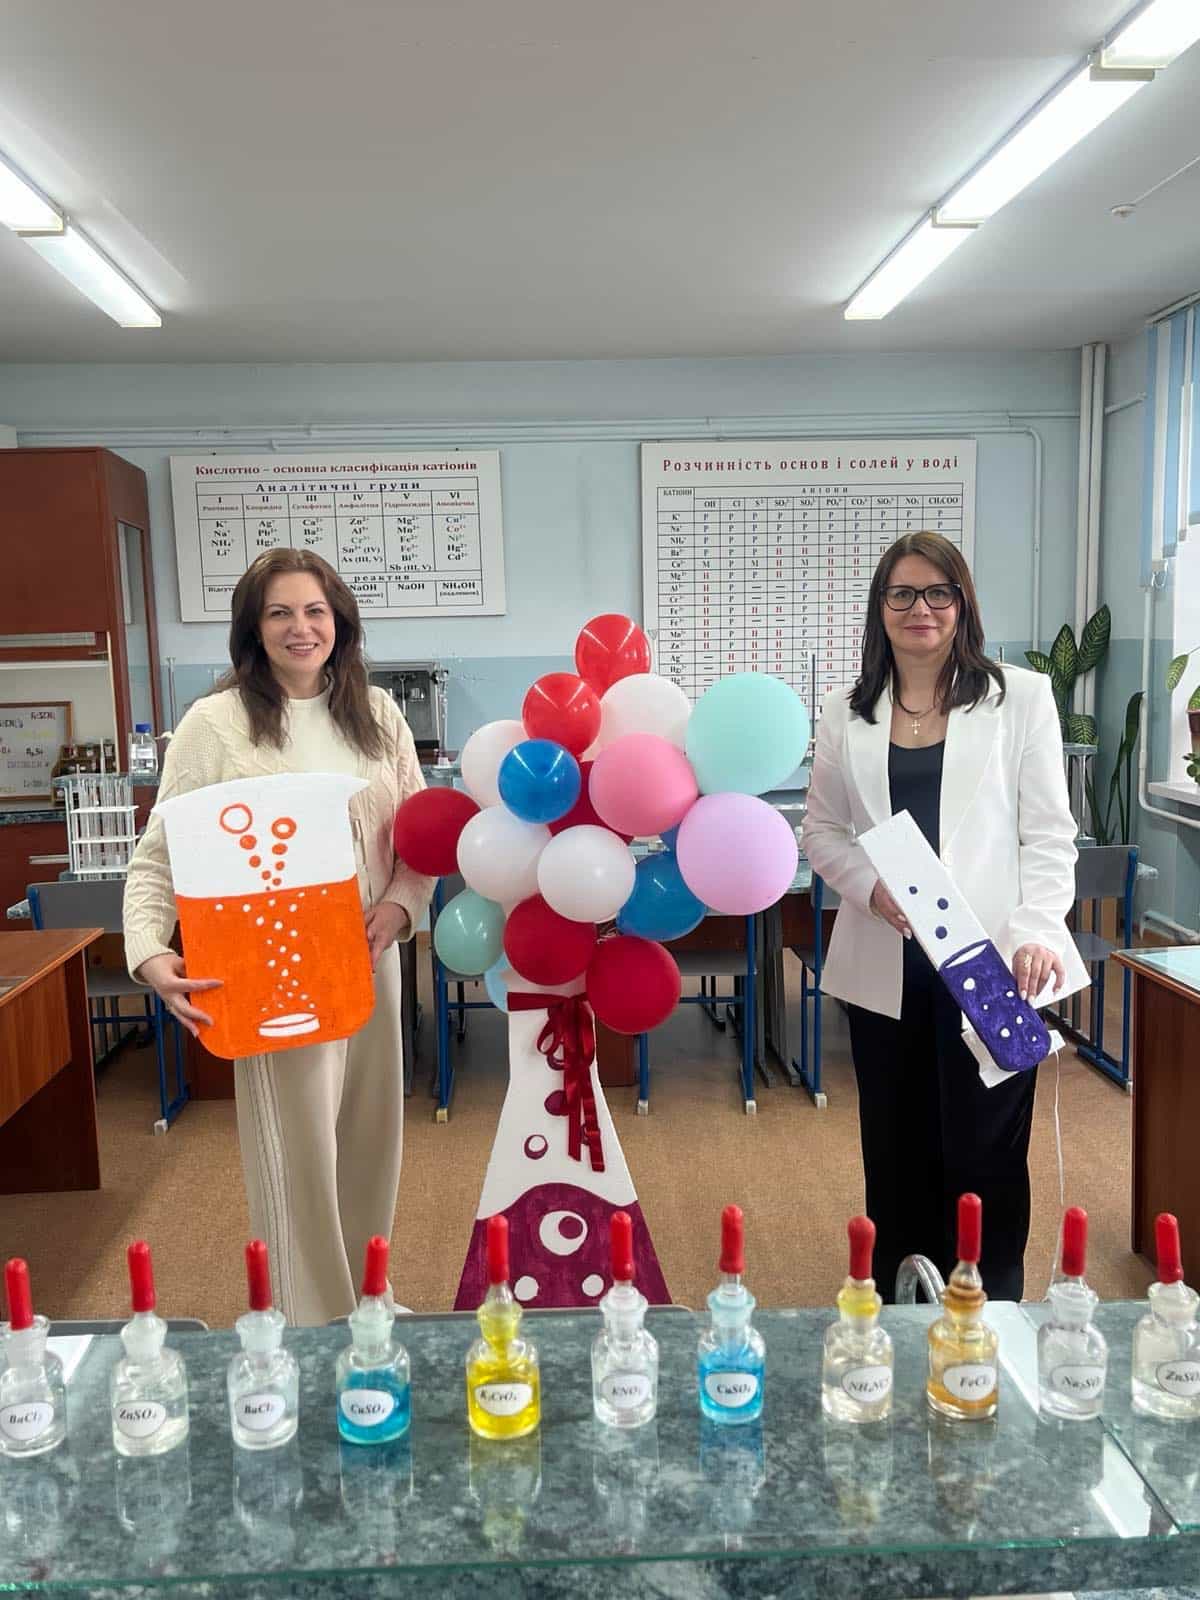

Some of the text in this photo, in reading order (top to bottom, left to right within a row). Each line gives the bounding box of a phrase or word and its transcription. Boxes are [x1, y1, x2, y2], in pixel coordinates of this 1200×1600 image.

[195, 466, 260, 475] Кислотно
[273, 466, 327, 474] основна
[330, 463, 419, 475] класифікація
[423, 462, 477, 471] катіонів
[663, 459, 772, 471] Розчинність
[780, 459, 829, 470] основ
[850, 456, 898, 468] солей
[906, 459, 914, 470] у
[922, 456, 958, 470] воді
[256, 482, 420, 492] Аналітичні групи
[353, 575, 410, 583] реактив
[1165, 1370, 1200, 1382] ZnSO
